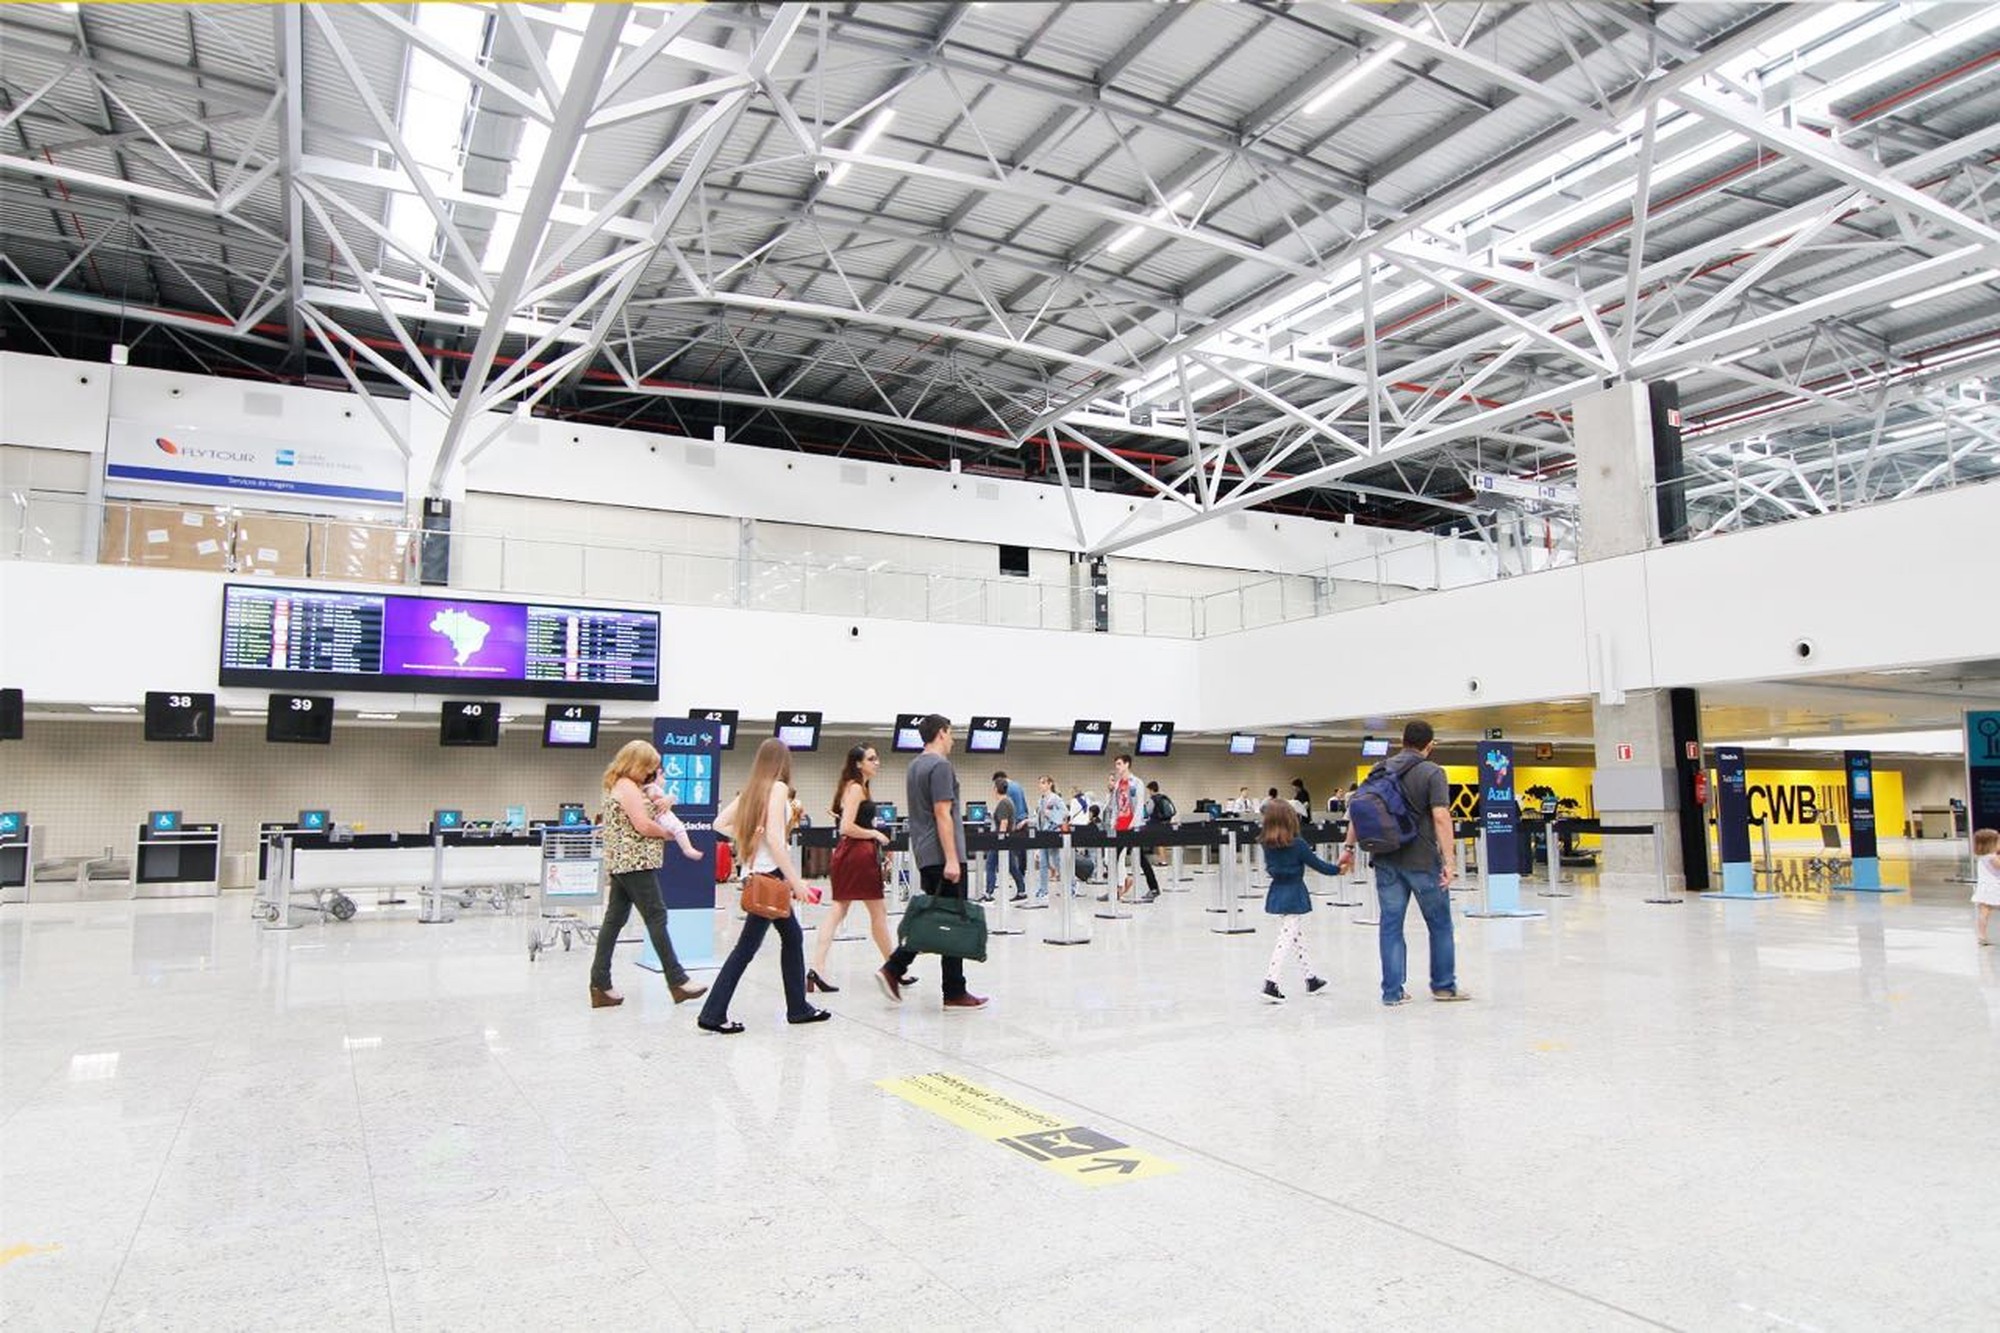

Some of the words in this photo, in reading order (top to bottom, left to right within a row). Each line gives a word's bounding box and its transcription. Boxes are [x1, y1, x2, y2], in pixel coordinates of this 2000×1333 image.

[181, 447, 256, 462] FLYTOUR
[169, 695, 192, 708] 38
[291, 698, 313, 711] 39
[462, 704, 483, 716] 40
[564, 707, 582, 718] 41
[705, 712, 723, 722] 42
[791, 714, 807, 724] 43
[983, 719, 998, 729] 45
[1086, 722, 1100, 732] 46
[1150, 723, 1163, 732] 47
[663, 733, 697, 746] Azul
[1487, 787, 1512, 801] Azul
[1747, 785, 1817, 827] CWB
